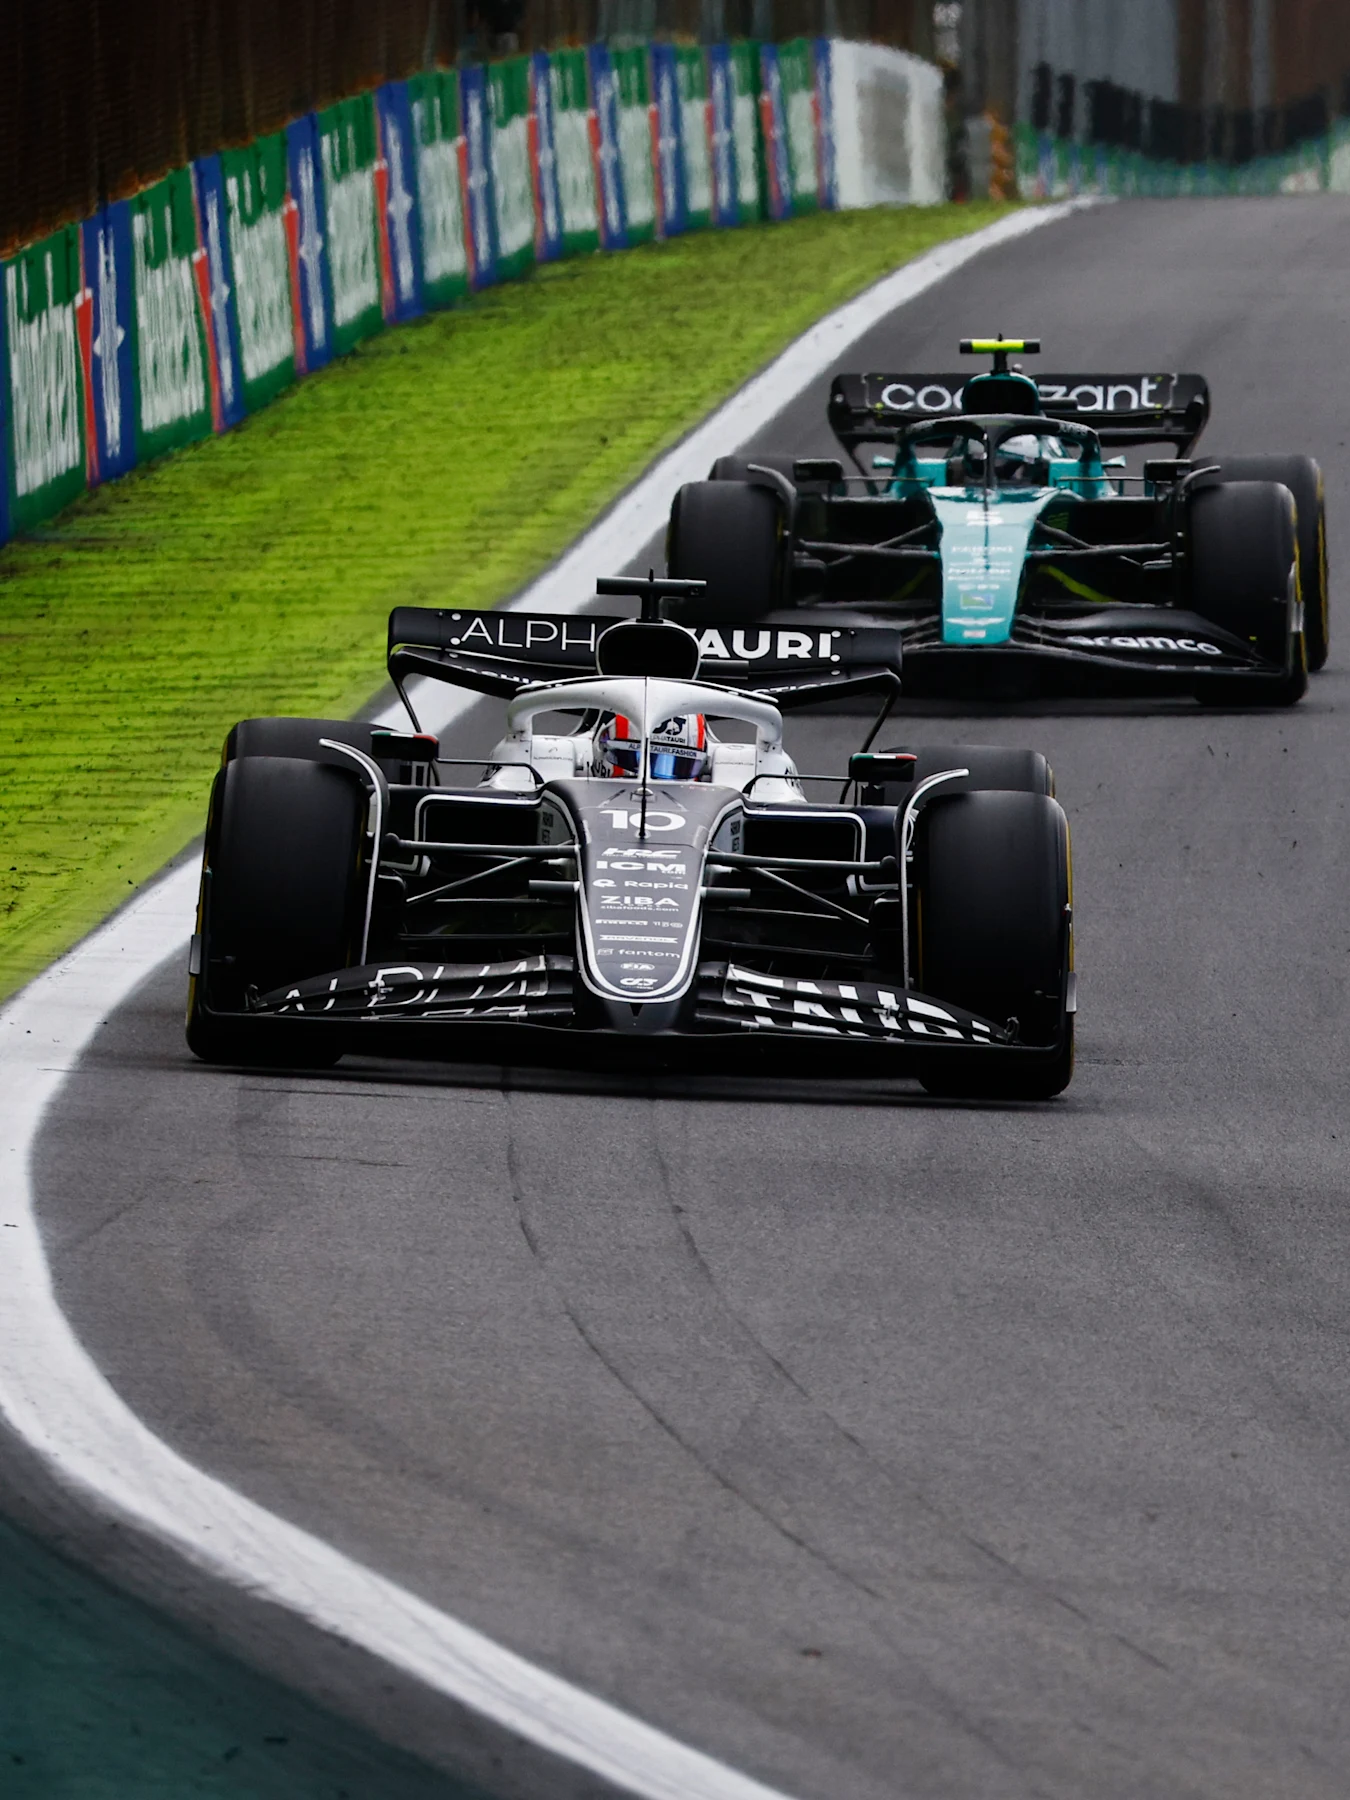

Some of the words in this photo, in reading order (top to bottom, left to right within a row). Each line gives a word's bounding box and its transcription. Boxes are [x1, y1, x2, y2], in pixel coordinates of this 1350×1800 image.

[881, 377, 1157, 412] cozant
[1068, 635, 1222, 655] aramco
[599, 810, 686, 831] 10
[596, 860, 686, 871] ICM
[600, 895, 679, 906] ZIBA
[618, 949, 680, 958] fantom
